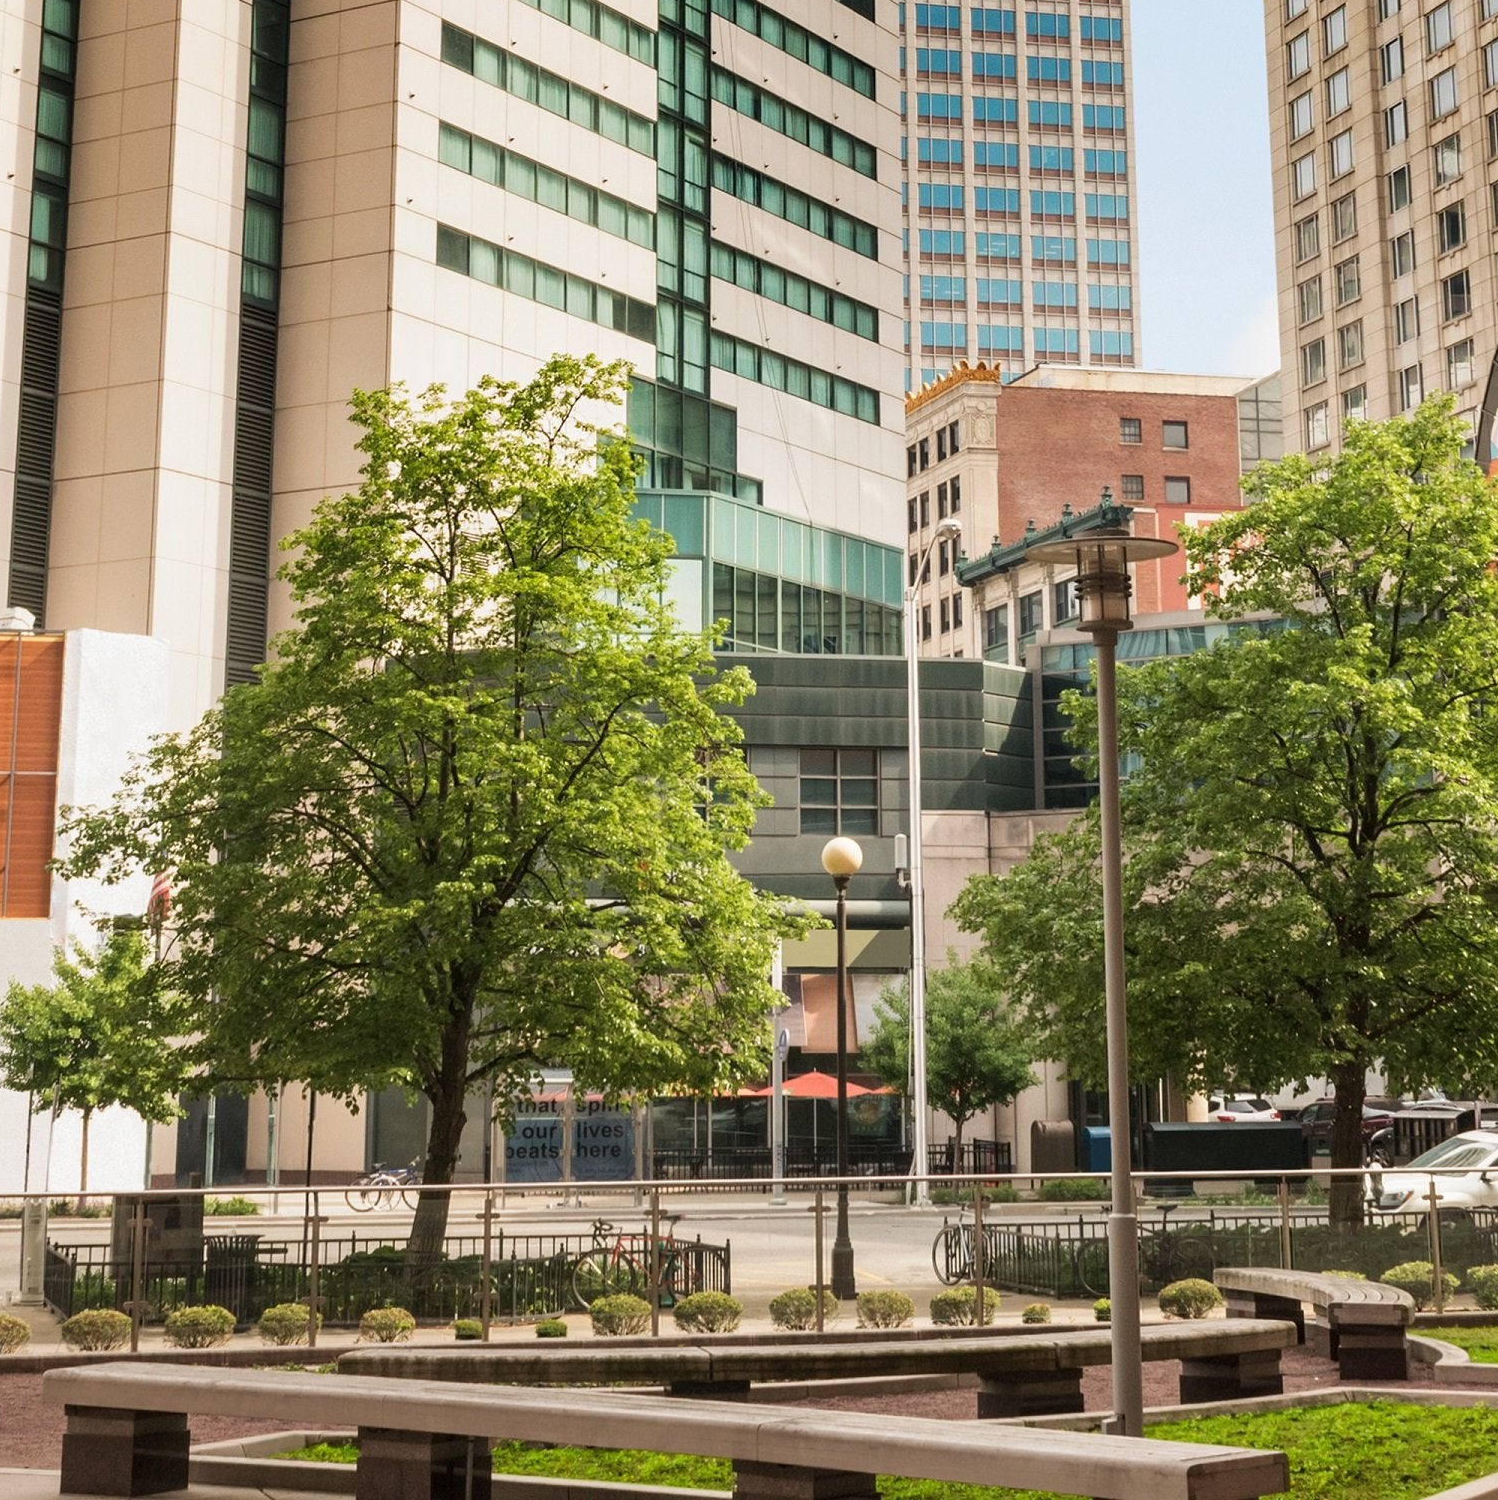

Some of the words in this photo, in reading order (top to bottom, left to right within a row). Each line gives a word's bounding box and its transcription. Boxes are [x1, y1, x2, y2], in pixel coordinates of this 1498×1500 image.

[517, 1098, 558, 1113] that
[522, 1126, 558, 1139] our
[577, 1121, 624, 1139] lives
[577, 1142, 622, 1158] here
